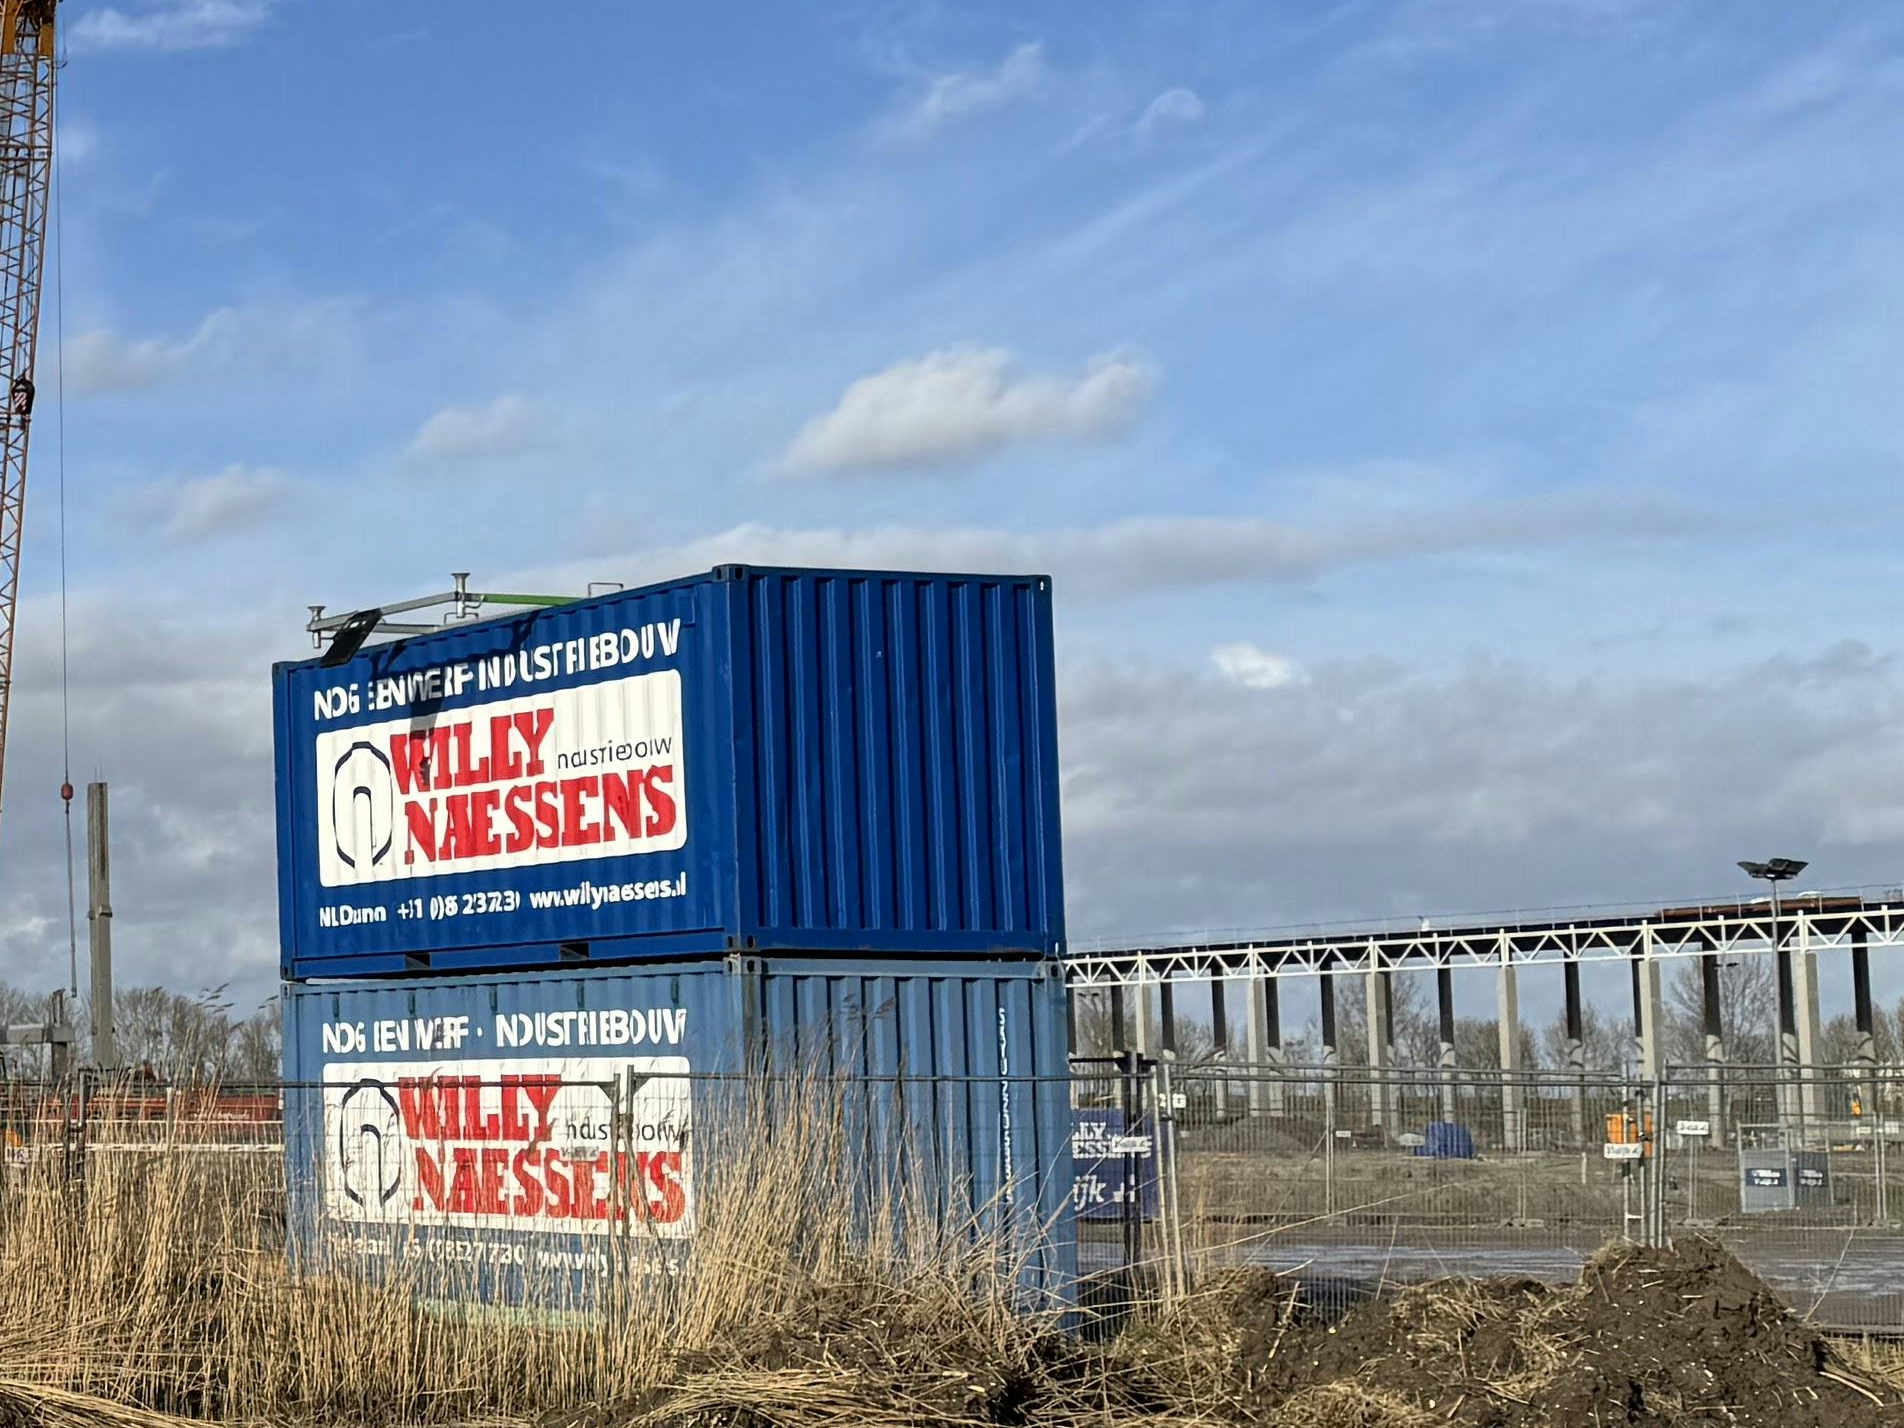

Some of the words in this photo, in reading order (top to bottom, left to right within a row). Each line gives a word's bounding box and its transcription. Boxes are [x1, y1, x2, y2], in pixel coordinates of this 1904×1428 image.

[390, 708, 555, 795] WILLY
[404, 765, 677, 865] NAESSENS
[322, 1022, 366, 1053] NOG
[495, 1008, 687, 1047] NDUSTRIEBOUW
[398, 1074, 562, 1142] WILLY
[412, 1147, 687, 1225] NAESSENS
